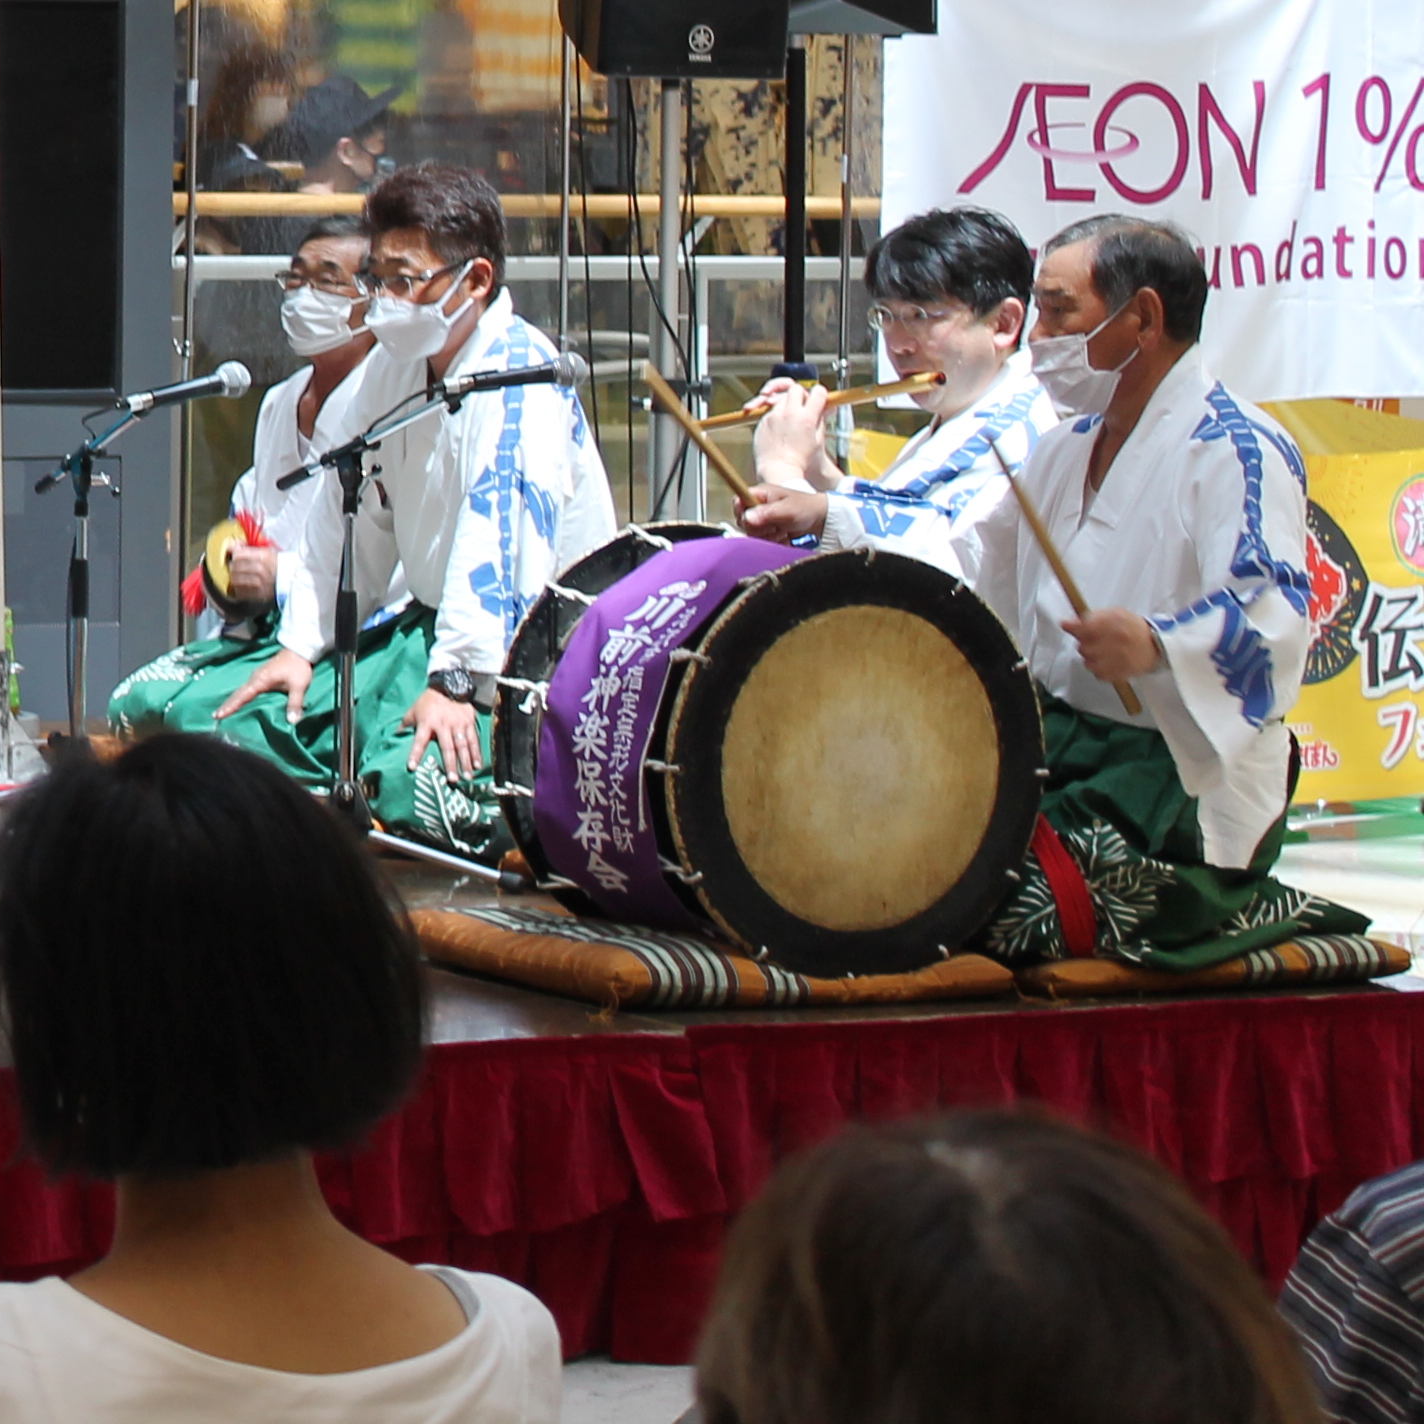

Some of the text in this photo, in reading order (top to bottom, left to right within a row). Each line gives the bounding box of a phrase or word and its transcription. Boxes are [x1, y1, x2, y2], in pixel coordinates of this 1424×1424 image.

[571, 594, 687, 894] 川前神楽保存会
